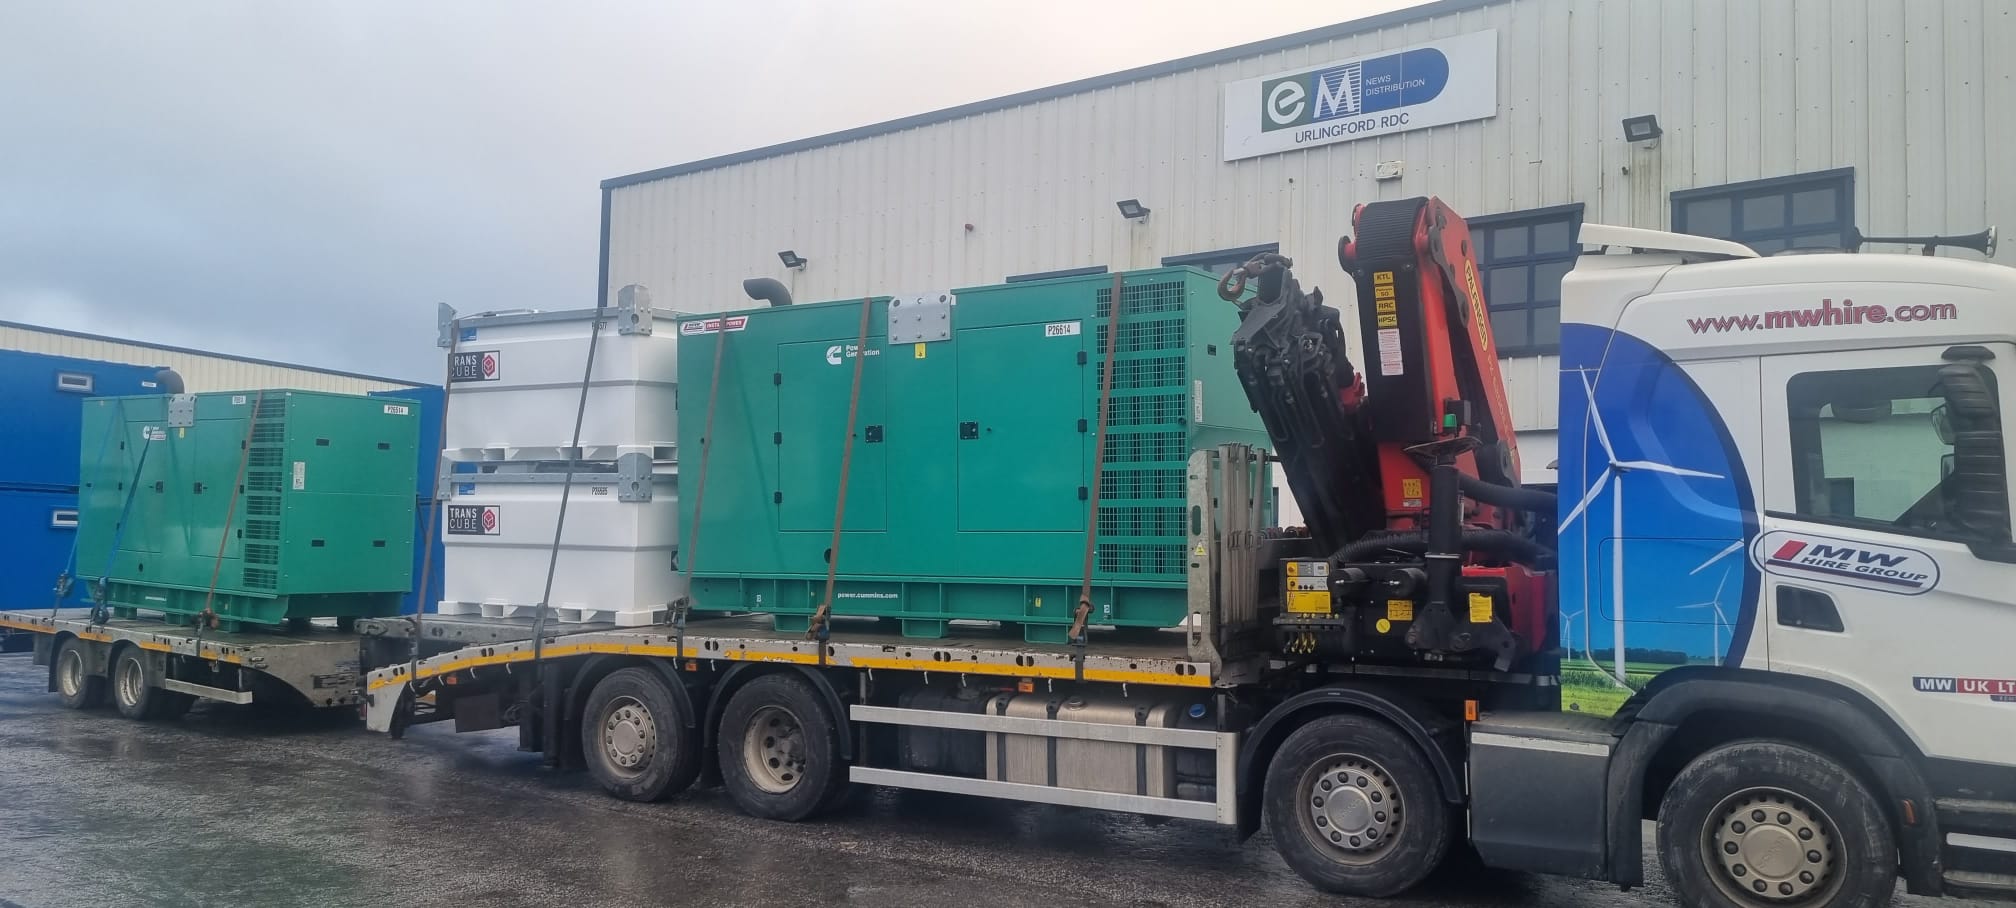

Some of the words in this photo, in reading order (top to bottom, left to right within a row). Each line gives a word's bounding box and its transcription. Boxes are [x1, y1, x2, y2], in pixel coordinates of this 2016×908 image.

[1366, 74, 1391, 85] NEWS
[1366, 79, 1425, 96] DISTRIBUTION
[1295, 119, 1375, 143] URLINGFORD
[1381, 112, 1409, 128] RDC
[1466, 265, 1487, 345] PALFINGER
[1687, 299, 1957, 334] www.mwhire.com
[454, 354, 477, 366] RANS
[450, 508, 477, 519] TRANS
[450, 519, 477, 530] CUBE
[1809, 544, 1908, 567] MW
[1800, 557, 1851, 570] HIRE
[1855, 565, 1928, 581] GROUP
[1920, 679, 1952, 690] MW
[1963, 680, 1989, 692] UK
